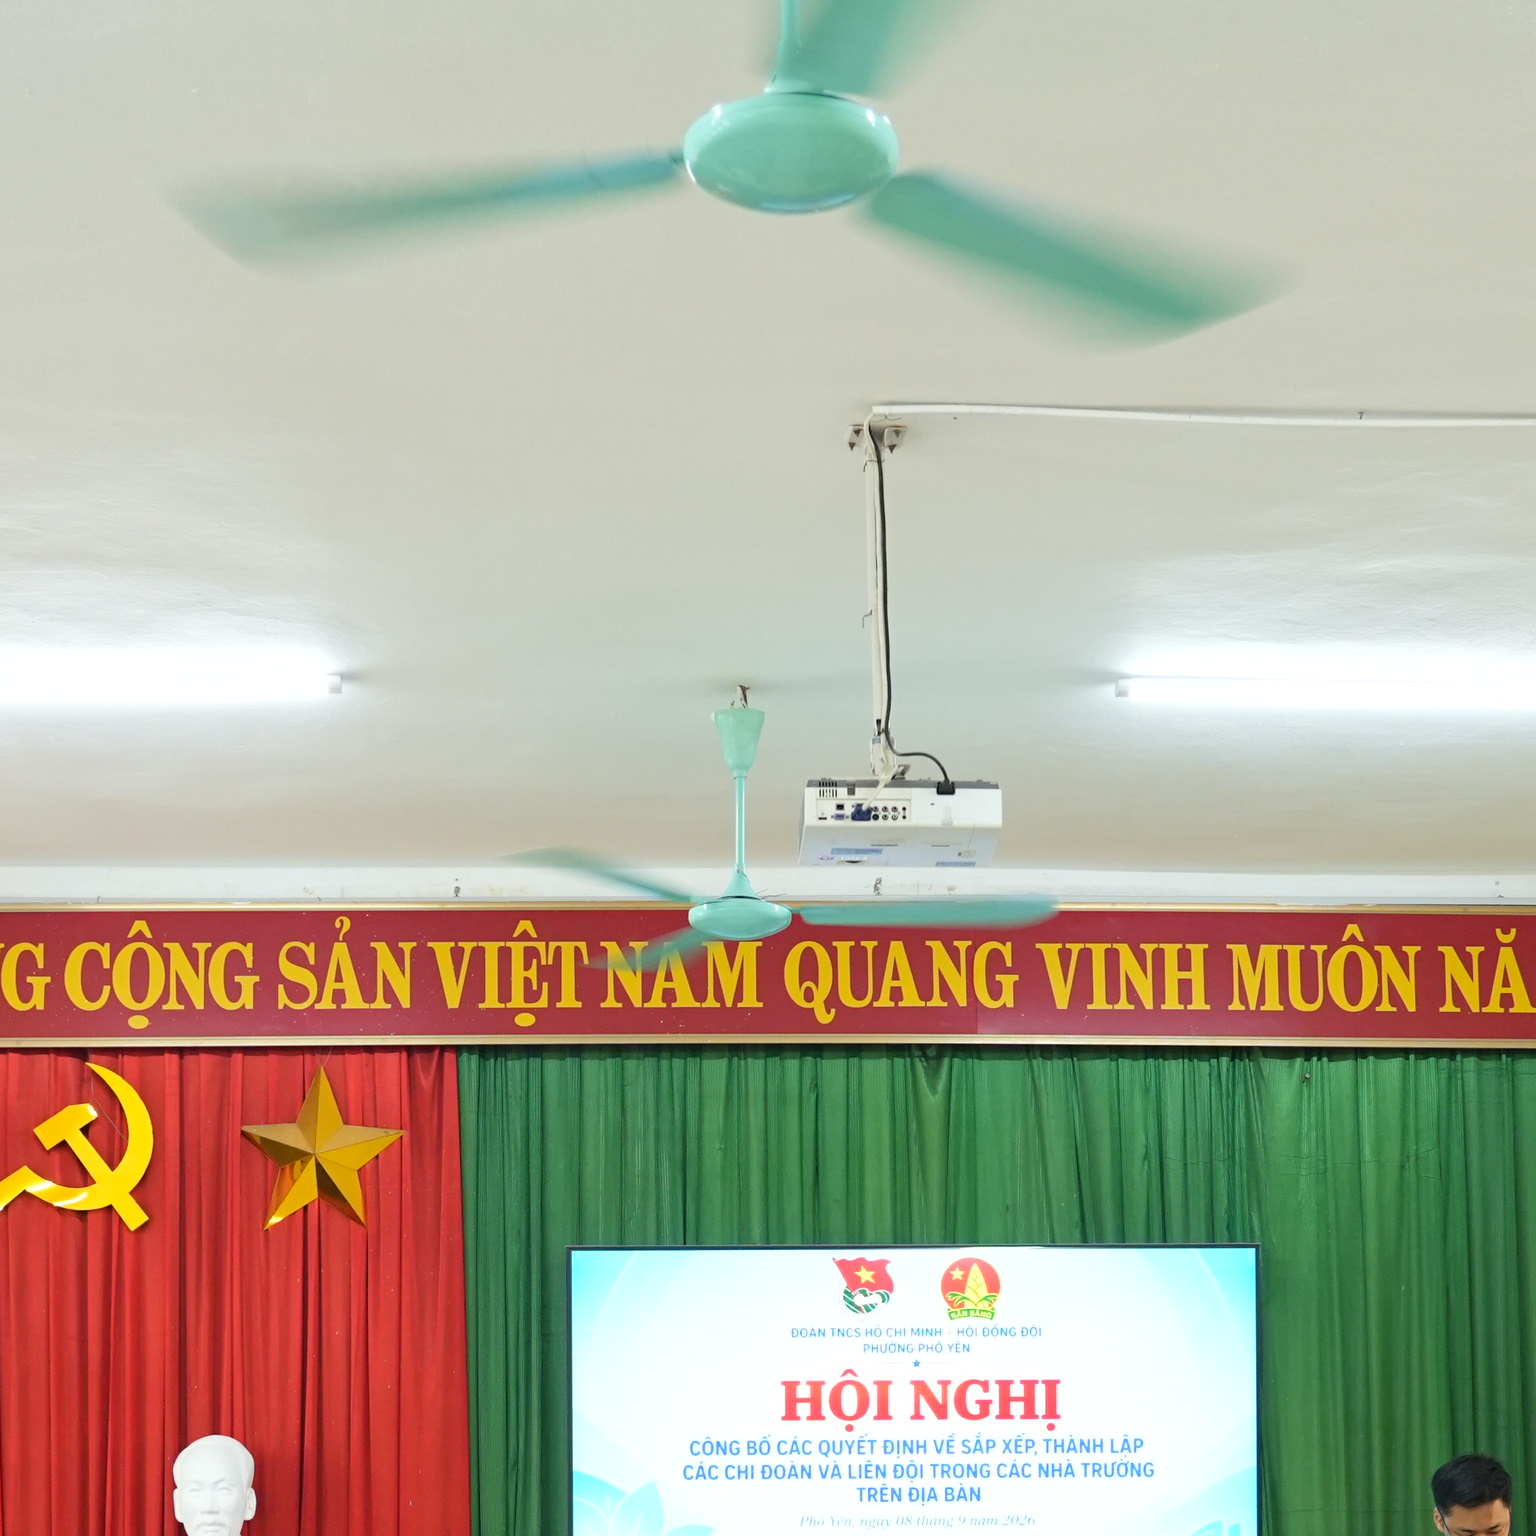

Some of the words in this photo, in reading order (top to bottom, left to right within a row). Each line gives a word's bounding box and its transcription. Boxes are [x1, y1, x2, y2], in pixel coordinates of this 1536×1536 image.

[65, 920, 262, 1029] CỘNG
[279, 916, 419, 1011] SẢN
[430, 920, 590, 1027] VIỆT
[600, 941, 764, 1008] NAM
[784, 941, 1021, 1024] QUANG
[1038, 943, 1211, 1010] VINH
[1230, 924, 1423, 1013] MUÔN
[791, 1325, 826, 1338] ĐOÀN
[830, 1327, 861, 1338] TNCS
[886, 1325, 906, 1338] CHÍ
[910, 1327, 943, 1337] MINH
[957, 1325, 978, 1339] HỘI
[982, 1323, 1017, 1337] ĐỒNG
[1021, 1325, 1042, 1339] ĐỘI
[863, 1341, 914, 1354] PHƯỜNG
[918, 1340, 943, 1353] PHỔ
[947, 1341, 971, 1353] YÊN
[781, 1368, 893, 1432] HỘI
[910, 1379, 1061, 1431] NGHỊ
[689, 1436, 741, 1456] CÔNG
[746, 1434, 772, 1455] BỐ
[777, 1436, 813, 1455] CÁC
[818, 1433, 877, 1457] QUYẾT
[882, 1439, 927, 1458] ĐỊNH
[933, 1433, 955, 1454] VỀ
[961, 1432, 996, 1454] SẮP
[1002, 1432, 1038, 1456] XẾP,
[1043, 1435, 1104, 1453] THÀNH
[1110, 1434, 1144, 1457] LẬP
[682, 1461, 719, 1480] CÁC
[724, 1464, 755, 1480] CHI
[760, 1461, 812, 1480] ĐOÀN
[818, 1460, 842, 1479] VÀ
[848, 1460, 887, 1479] LIÊN
[892, 1460, 924, 1483] ĐỘI
[929, 1463, 991, 1479] TRONG
[996, 1459, 1032, 1478] CÁC
[1038, 1459, 1076, 1478] NHÀ
[1080, 1459, 1155, 1478] TRƯỜNG
[856, 1483, 903, 1502] TRÊN
[908, 1486, 939, 1506] ĐỊA
[944, 1483, 981, 1502] BÀN
[860, 1516, 893, 1530] ngày
[895, 1514, 913, 1526] 08
[916, 1514, 954, 1529] tháng
[958, 1514, 967, 1526] 9
[969, 1514, 998, 1526] năm
[1002, 1514, 1037, 1526] 2026
